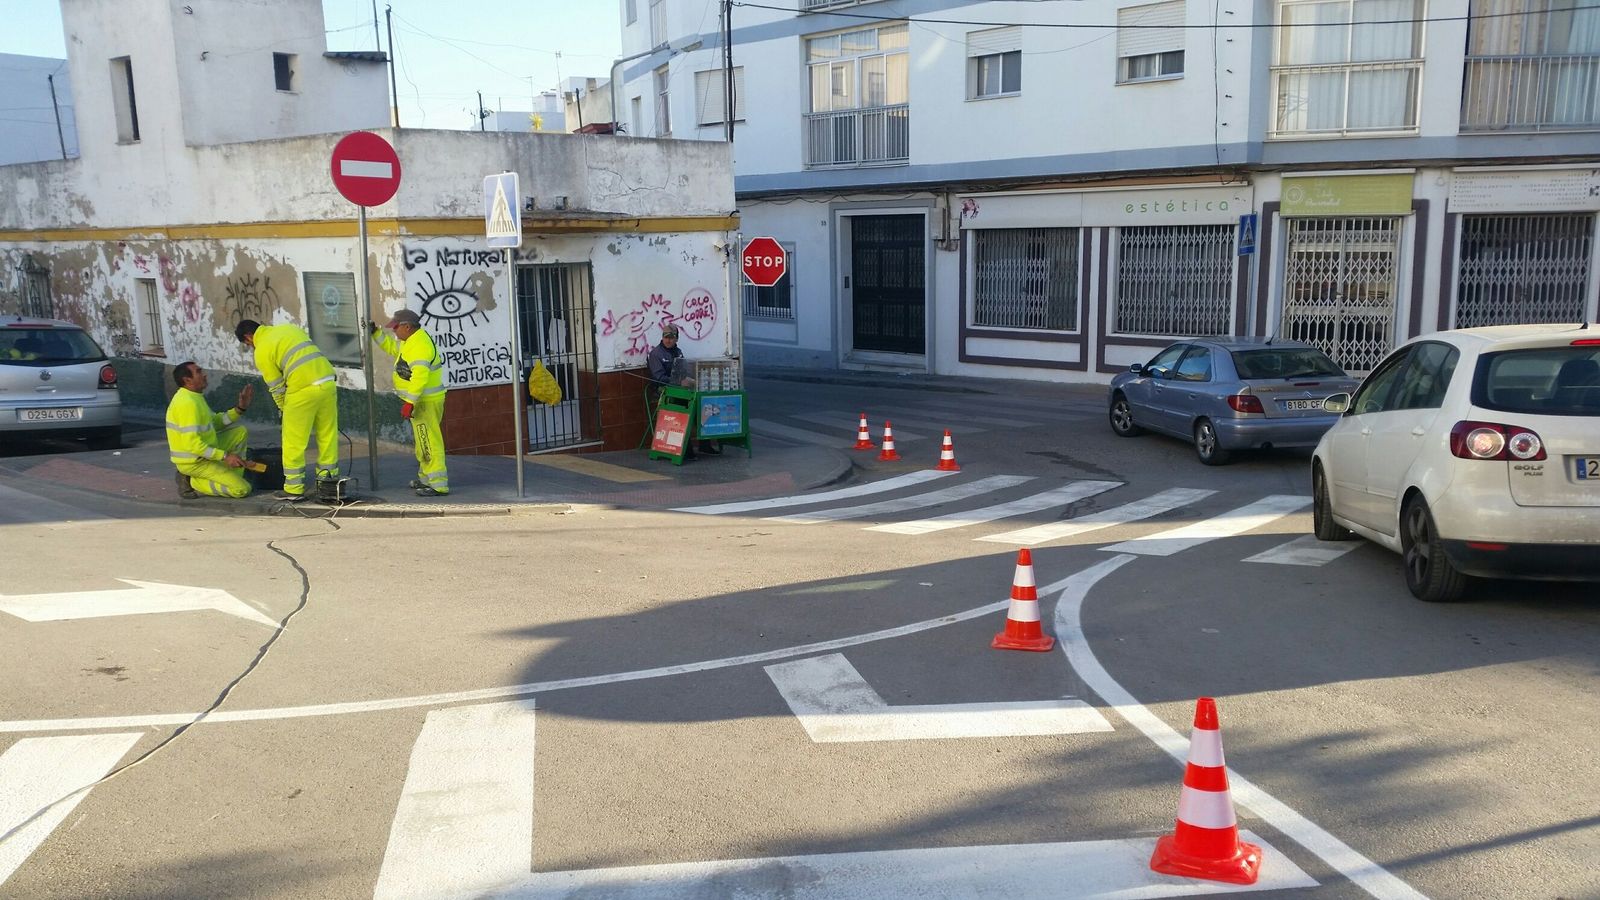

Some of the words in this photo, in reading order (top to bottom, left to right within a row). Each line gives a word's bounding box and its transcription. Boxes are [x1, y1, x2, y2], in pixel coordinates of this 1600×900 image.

[1125, 200, 1229, 214] estética
[744, 255, 783, 267] STOP
[432, 332, 466, 348] UNDO
[1287, 400, 1307, 410] 8180
[1310, 400, 1323, 409] CF
[27, 410, 54, 420] 0294
